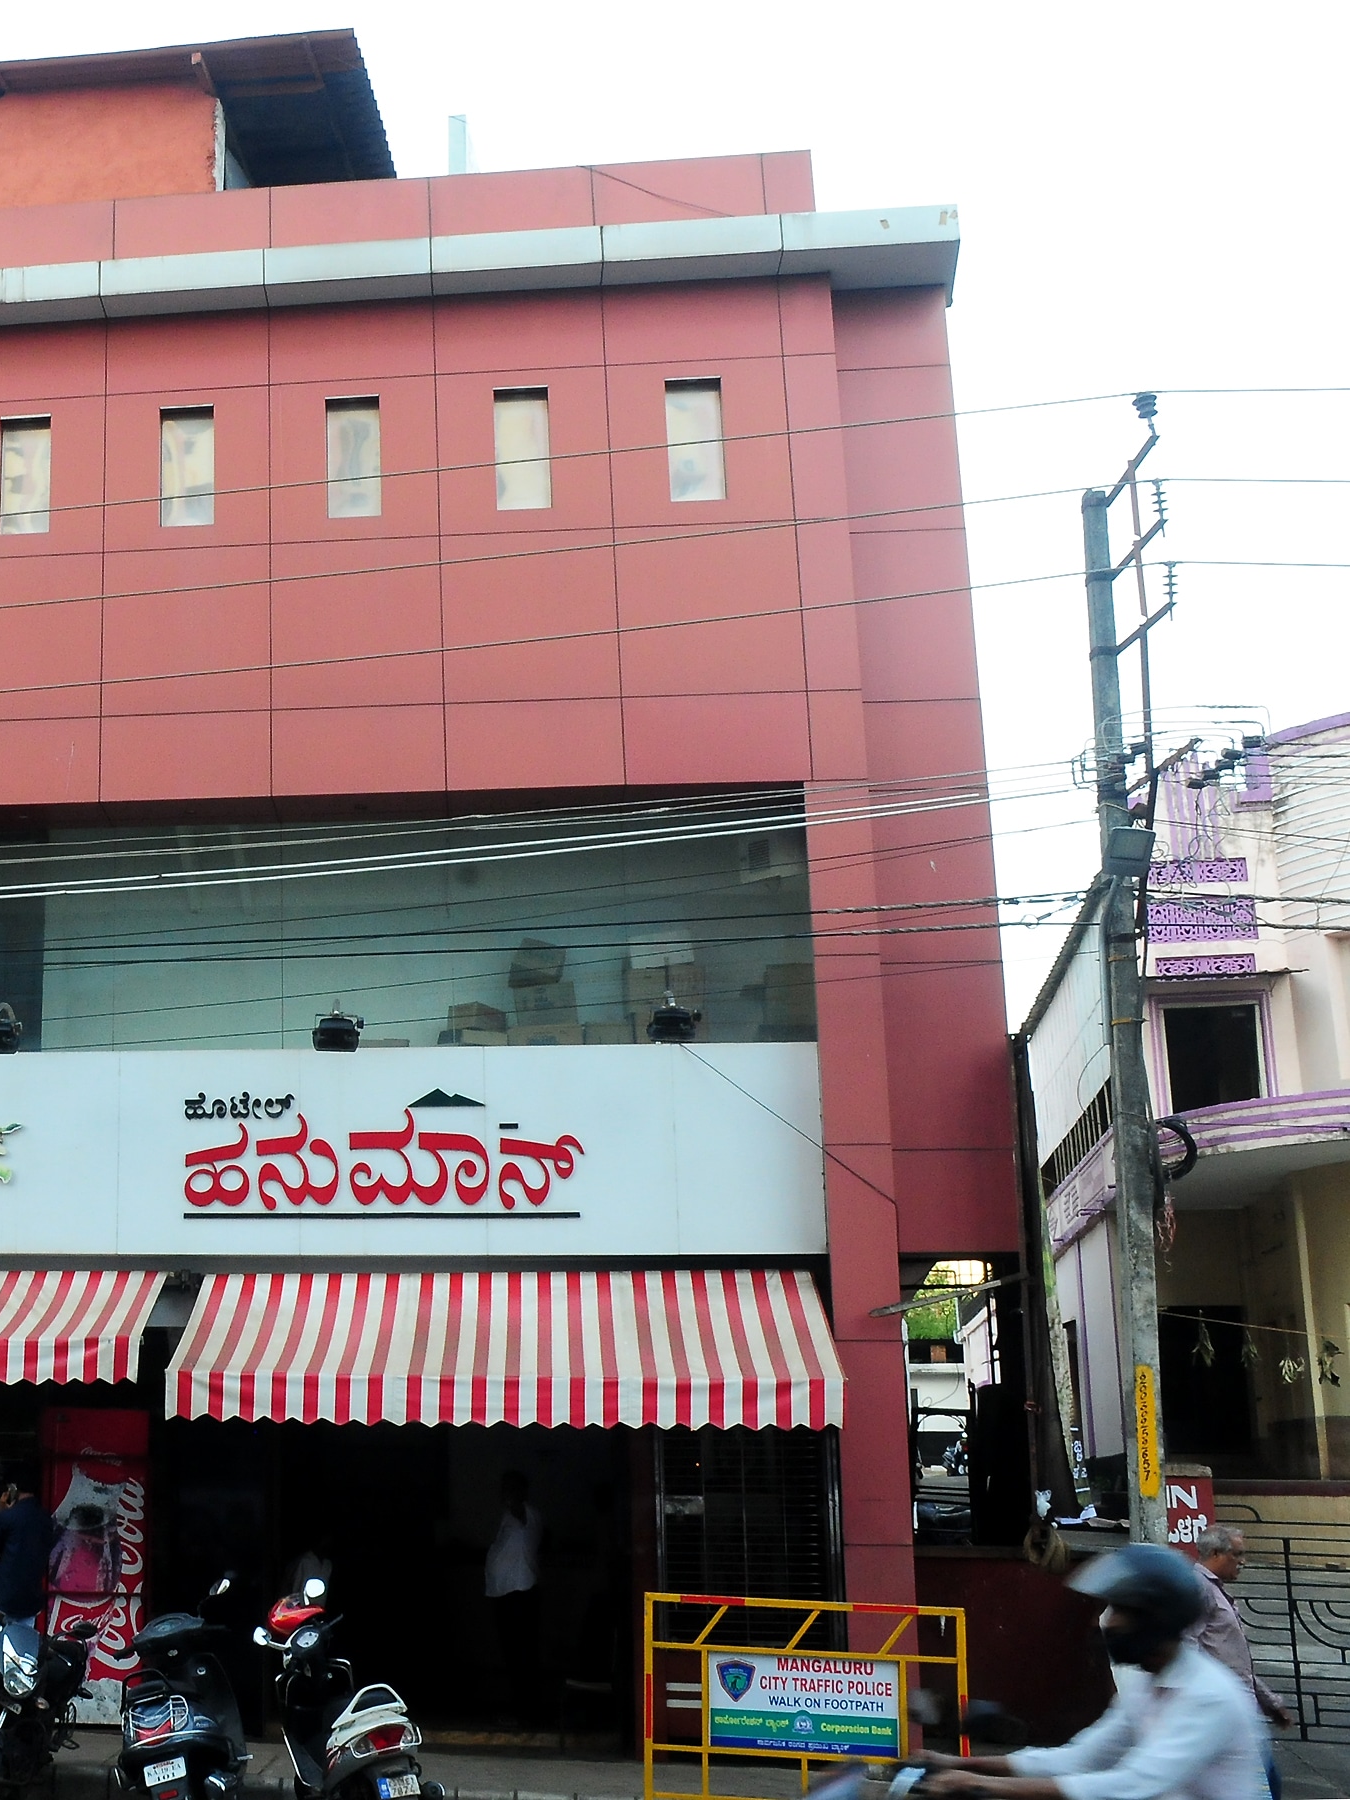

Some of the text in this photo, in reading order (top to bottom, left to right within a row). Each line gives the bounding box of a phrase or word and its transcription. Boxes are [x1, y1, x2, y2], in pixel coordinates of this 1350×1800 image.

[183, 1108, 585, 1211] ಹನುಮಾನ್
[777, 1657, 875, 1676] MANGALURU
[759, 1675, 893, 1697] CITY TRAFFIC POLICE
[768, 1695, 885, 1712] WALK ON FOOTPATH
[820, 1722, 893, 1736] Corporation Bank
